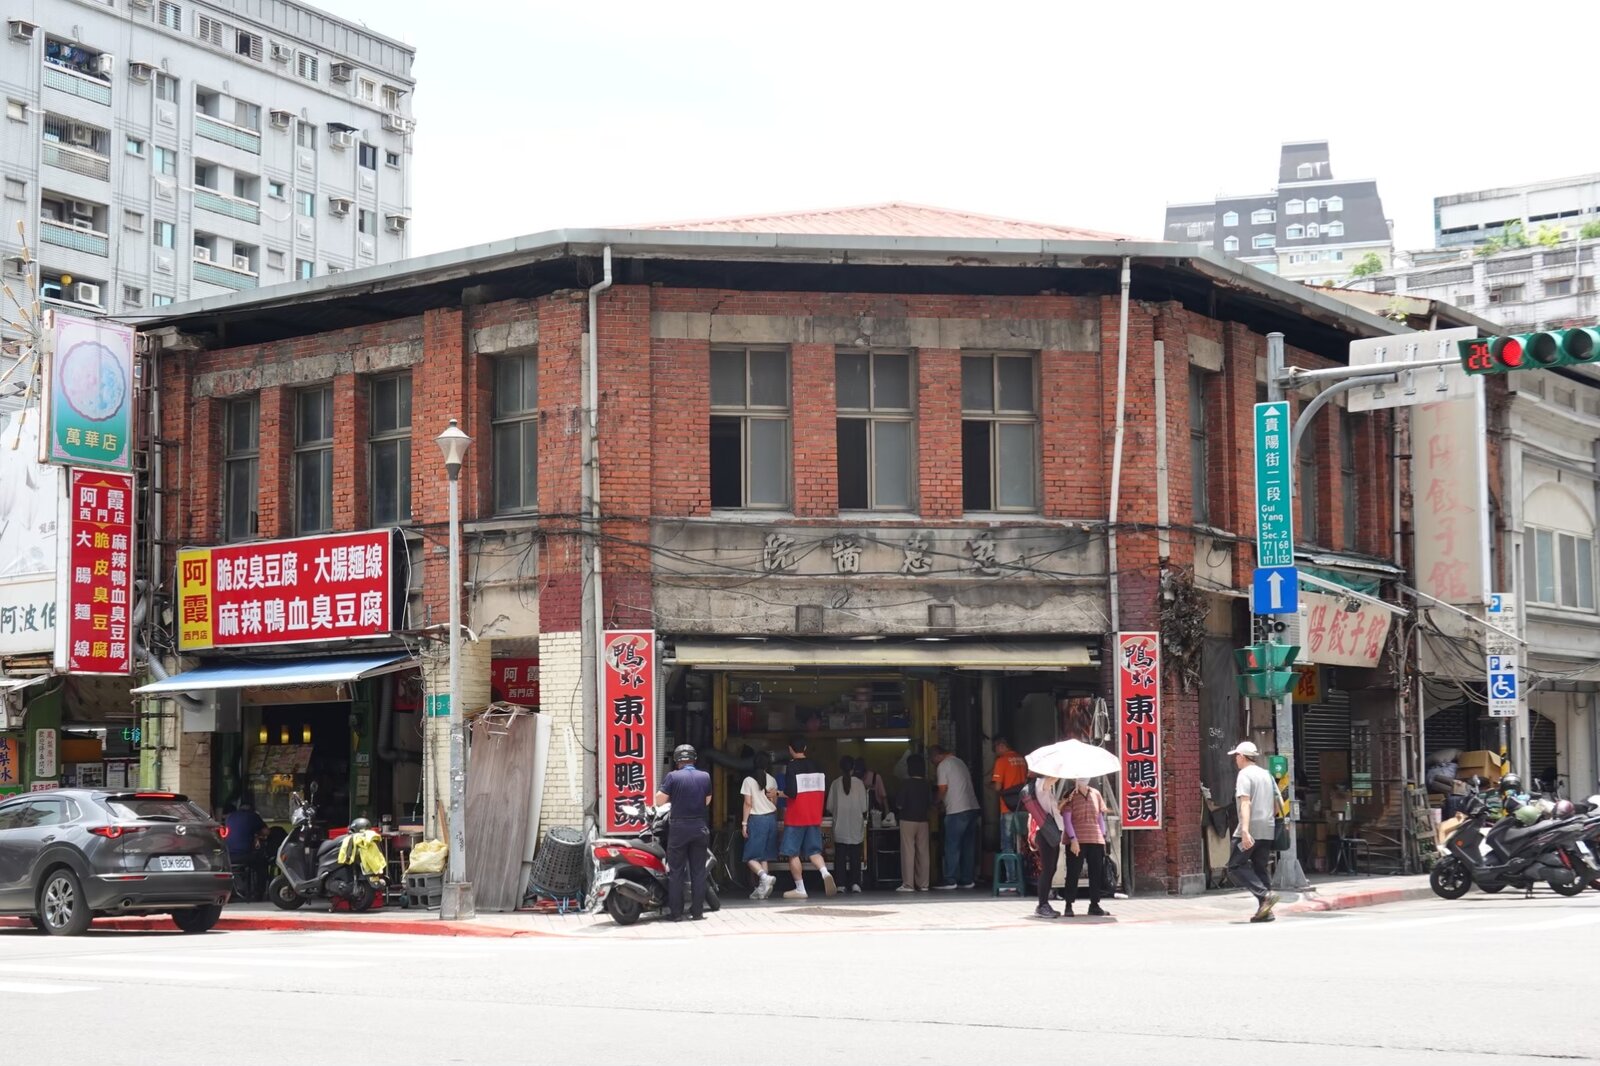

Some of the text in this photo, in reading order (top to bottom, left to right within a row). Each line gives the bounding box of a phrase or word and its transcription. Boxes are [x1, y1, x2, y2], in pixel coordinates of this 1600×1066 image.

[66, 427, 117, 451] 萬華店
[1265, 417, 1281, 501] 貴陽街二段
[80, 486, 125, 511] 阿霞
[80, 507, 125, 524] 西門店
[1261, 504, 1275, 512] Gui
[1261, 514, 1284, 523] Yang
[1281, 530, 1287, 539] 2
[1262, 541, 1272, 550] 77
[1278, 540, 1289, 550] 68
[1263, 555, 1273, 564] 117
[1278, 554, 1291, 564] 132
[74, 530, 91, 657] 大腸麵線
[92, 531, 110, 658] 脆皮臭豆腐
[110, 533, 127, 659] 麻辣鴨血臭豆腐
[183, 558, 209, 624] 阿霞
[218, 590, 383, 636] 麻辣鴨血臭豆腐
[184, 630, 208, 641] 西門店
[508, 688, 535, 698] 西門店
[1126, 694, 1159, 822] 東山鴨頭
